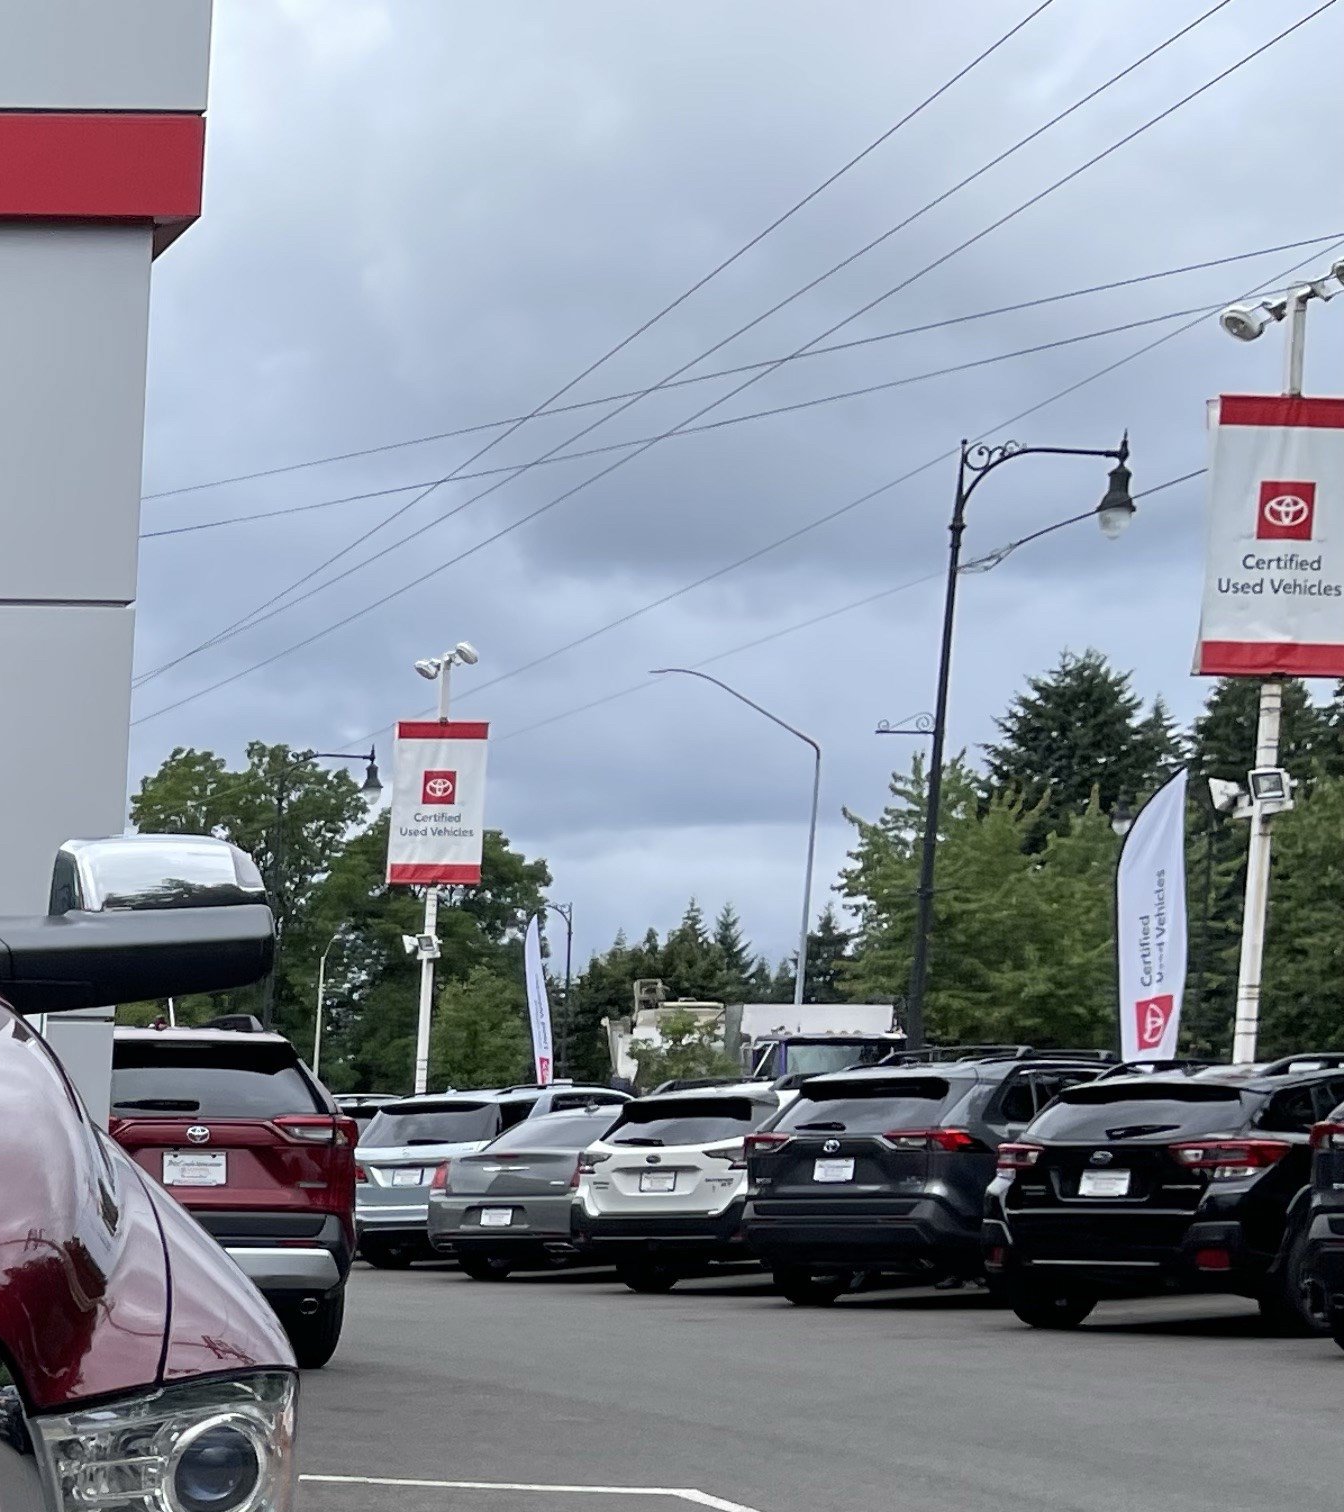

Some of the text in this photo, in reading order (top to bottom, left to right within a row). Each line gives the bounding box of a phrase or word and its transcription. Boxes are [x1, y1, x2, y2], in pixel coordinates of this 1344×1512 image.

[1242, 554, 1322, 571] Certified
[1217, 578, 1342, 597] Used Vehicles
[413, 812, 462, 823] Certified
[399, 827, 474, 837] Used Vehicles
[1139, 915, 1152, 987] Certified
